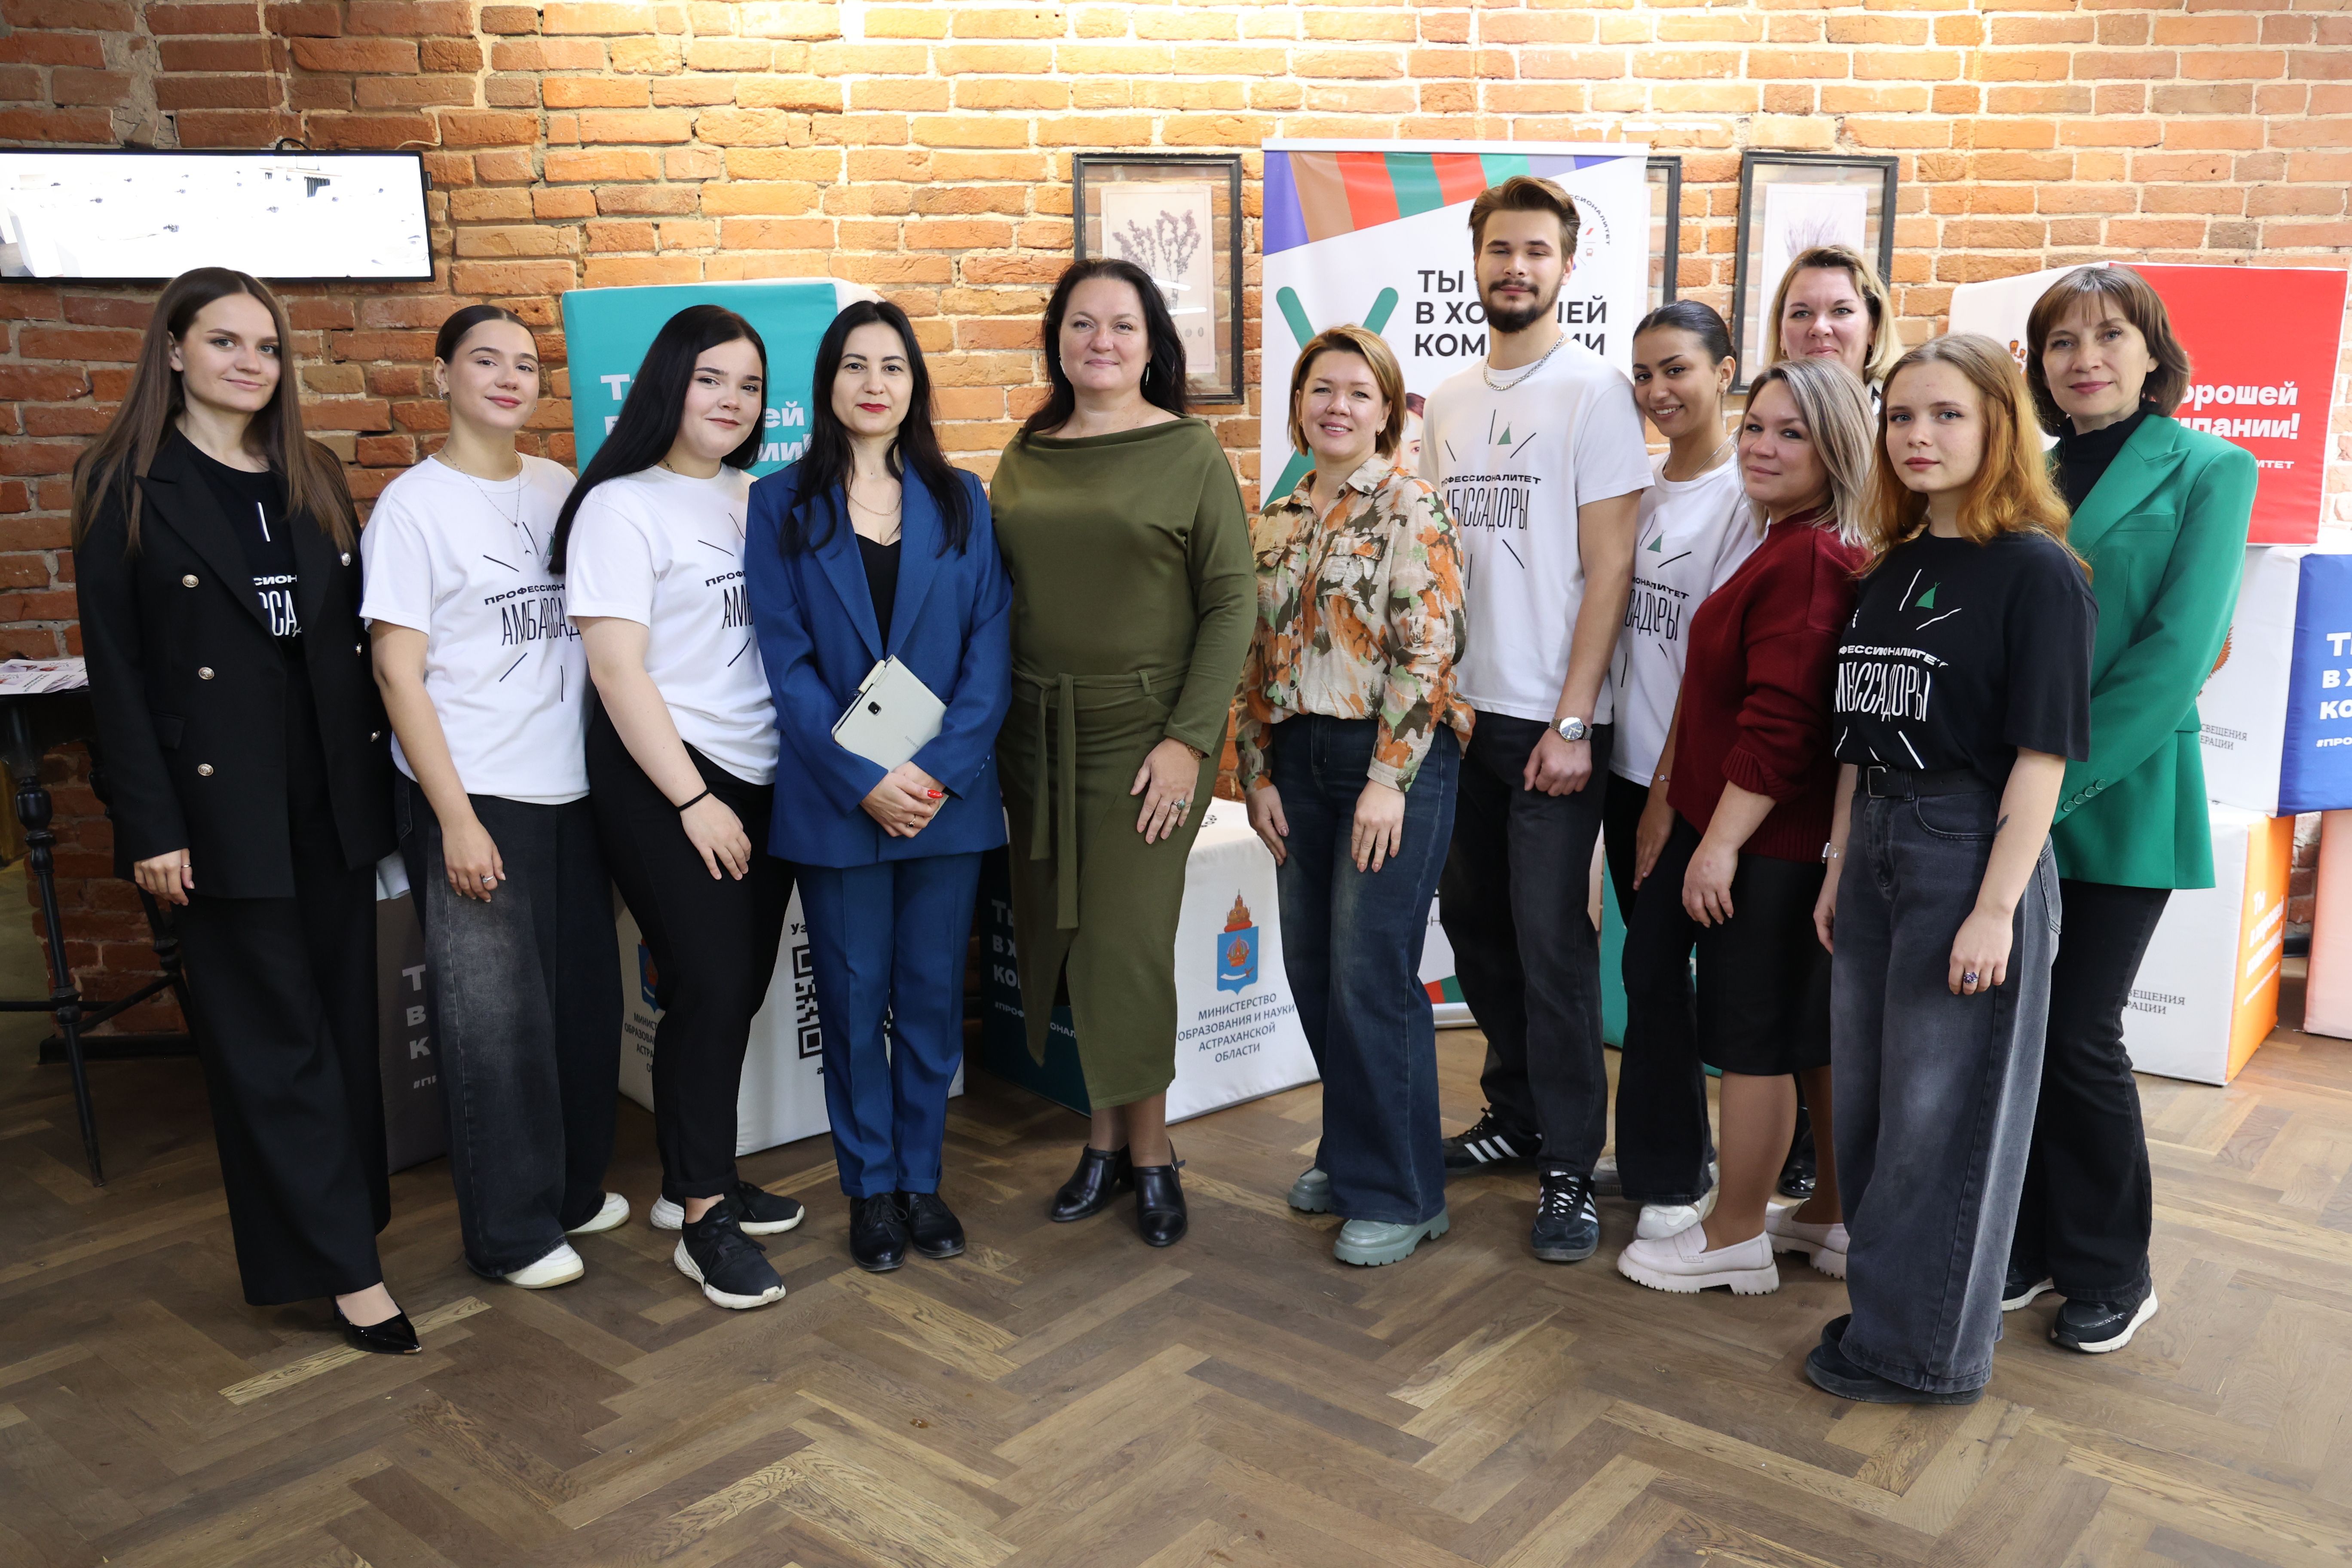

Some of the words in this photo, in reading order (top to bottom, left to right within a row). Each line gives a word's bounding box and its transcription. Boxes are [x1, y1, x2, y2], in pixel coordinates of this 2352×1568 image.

[1418, 270, 1464, 293] ТЫ
[1416, 302, 1435, 324] В
[2181, 381, 2298, 411] орошей
[484, 583, 566, 605] ПРОФЕССИОН
[2322, 669, 2341, 689] В
[2200, 735, 2234, 750] ЕРАЦИИ
[2201, 723, 2248, 741] СВЕЩЕНИЯ
[992, 934, 1004, 953] В
[1198, 993, 1277, 1021] МИНИСТЕРСТВО
[2128, 989, 2186, 1005] ВЕЩЕНИЯ
[406, 1005, 427, 1026] В
[1178, 1014, 1252, 1041] ОБРАЗОВАНИЯ
[1254, 1012, 1261, 1022] И
[1264, 1004, 1295, 1020] НАУКИ
[1198, 1022, 1276, 1052] АСТРАХАНСКОЙ
[1215, 1042, 1260, 1063] ОБЛАСТИ
